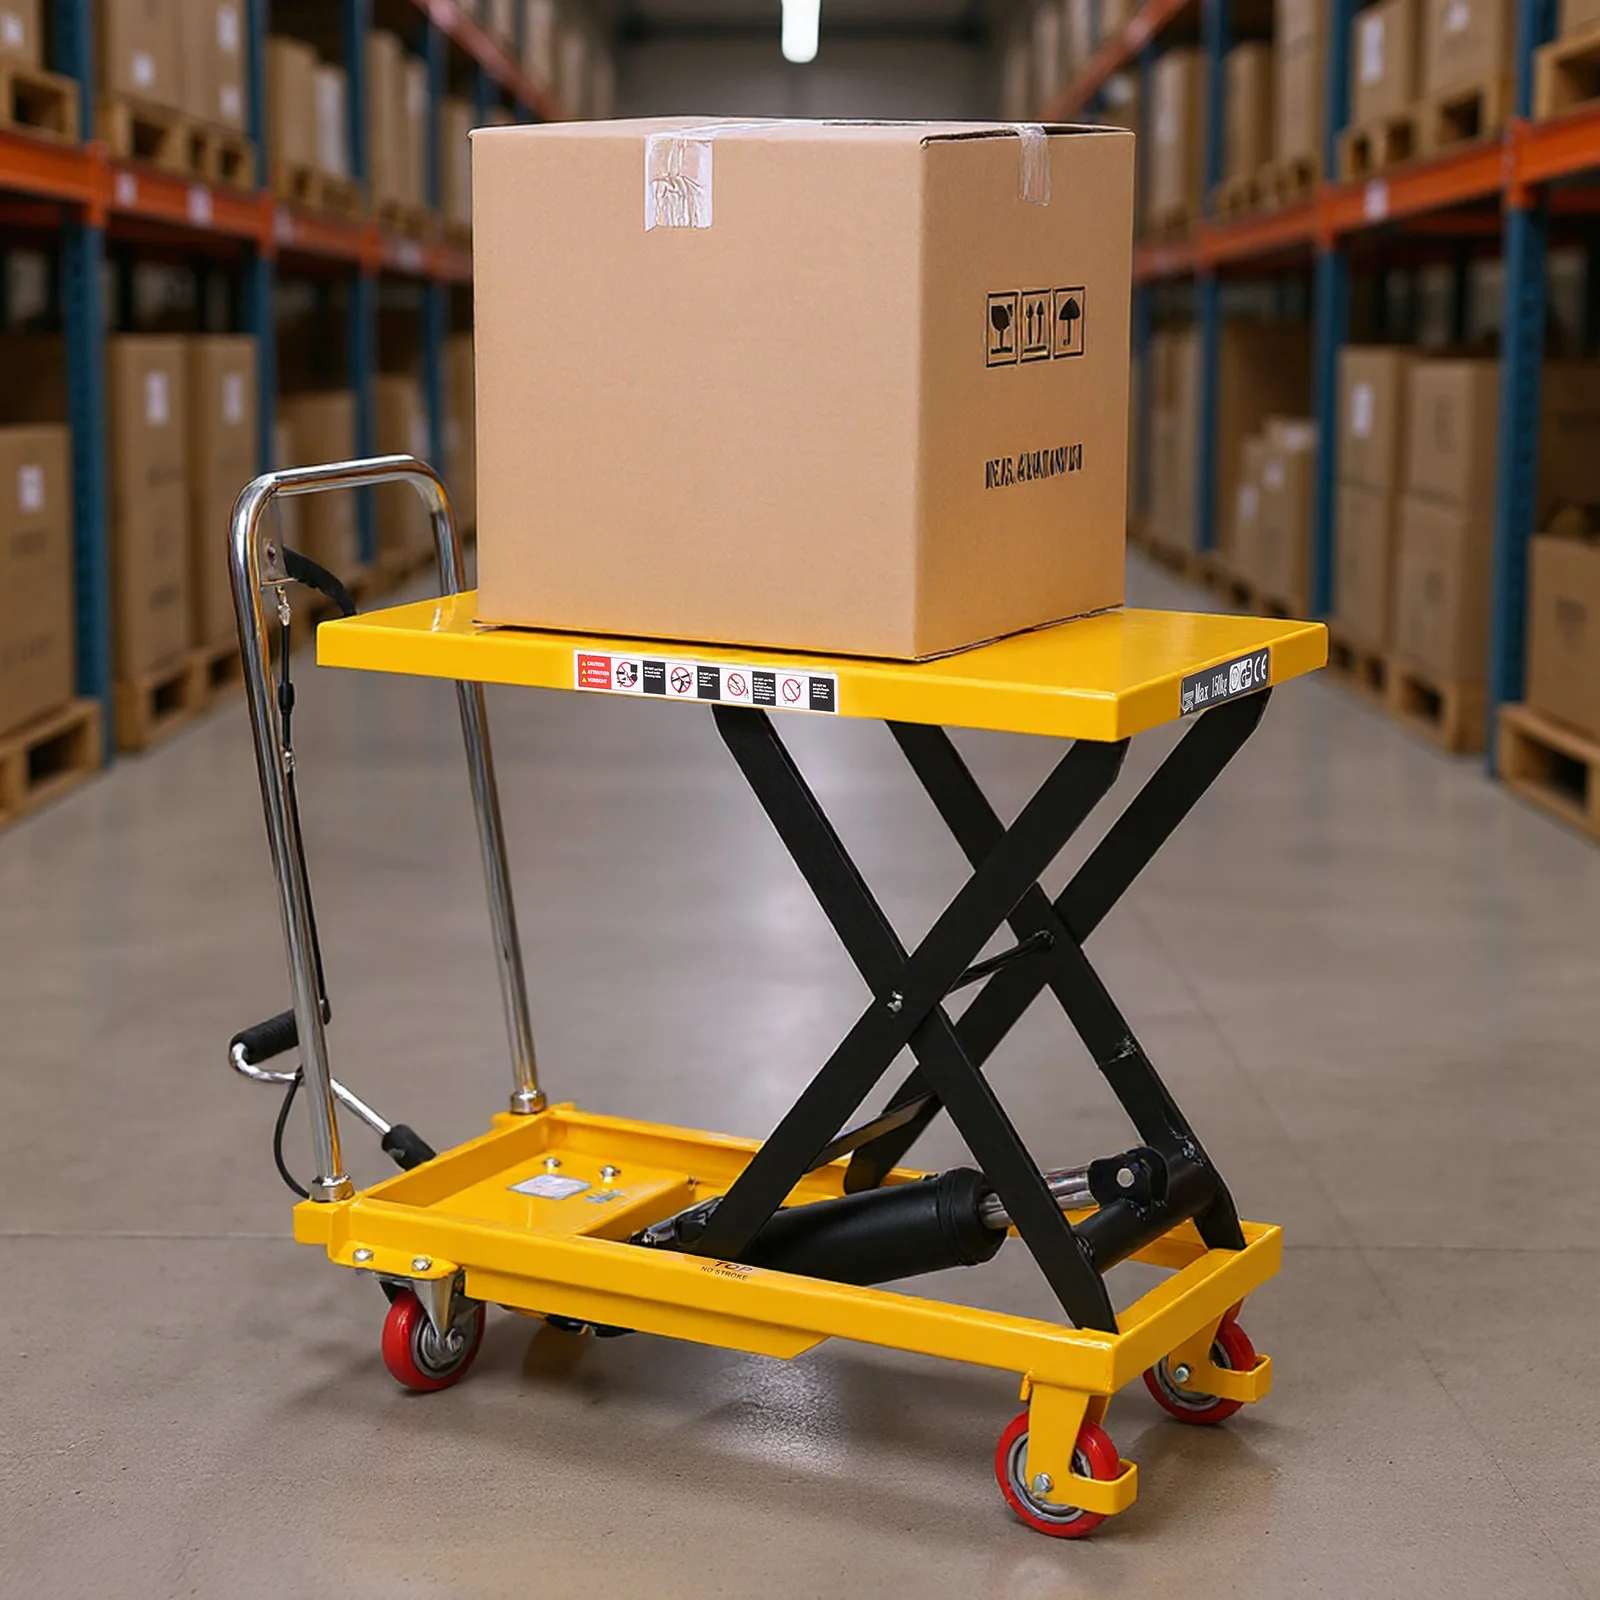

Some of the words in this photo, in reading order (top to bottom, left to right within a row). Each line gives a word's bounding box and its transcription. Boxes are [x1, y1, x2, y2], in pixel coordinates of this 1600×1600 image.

[1194, 681, 1209, 704] Max
[1211, 673, 1227, 697] 150kg
[701, 1265, 714, 1273] NO
[715, 1268, 749, 1281] STROKE
[715, 1260, 753, 1271] TOP
